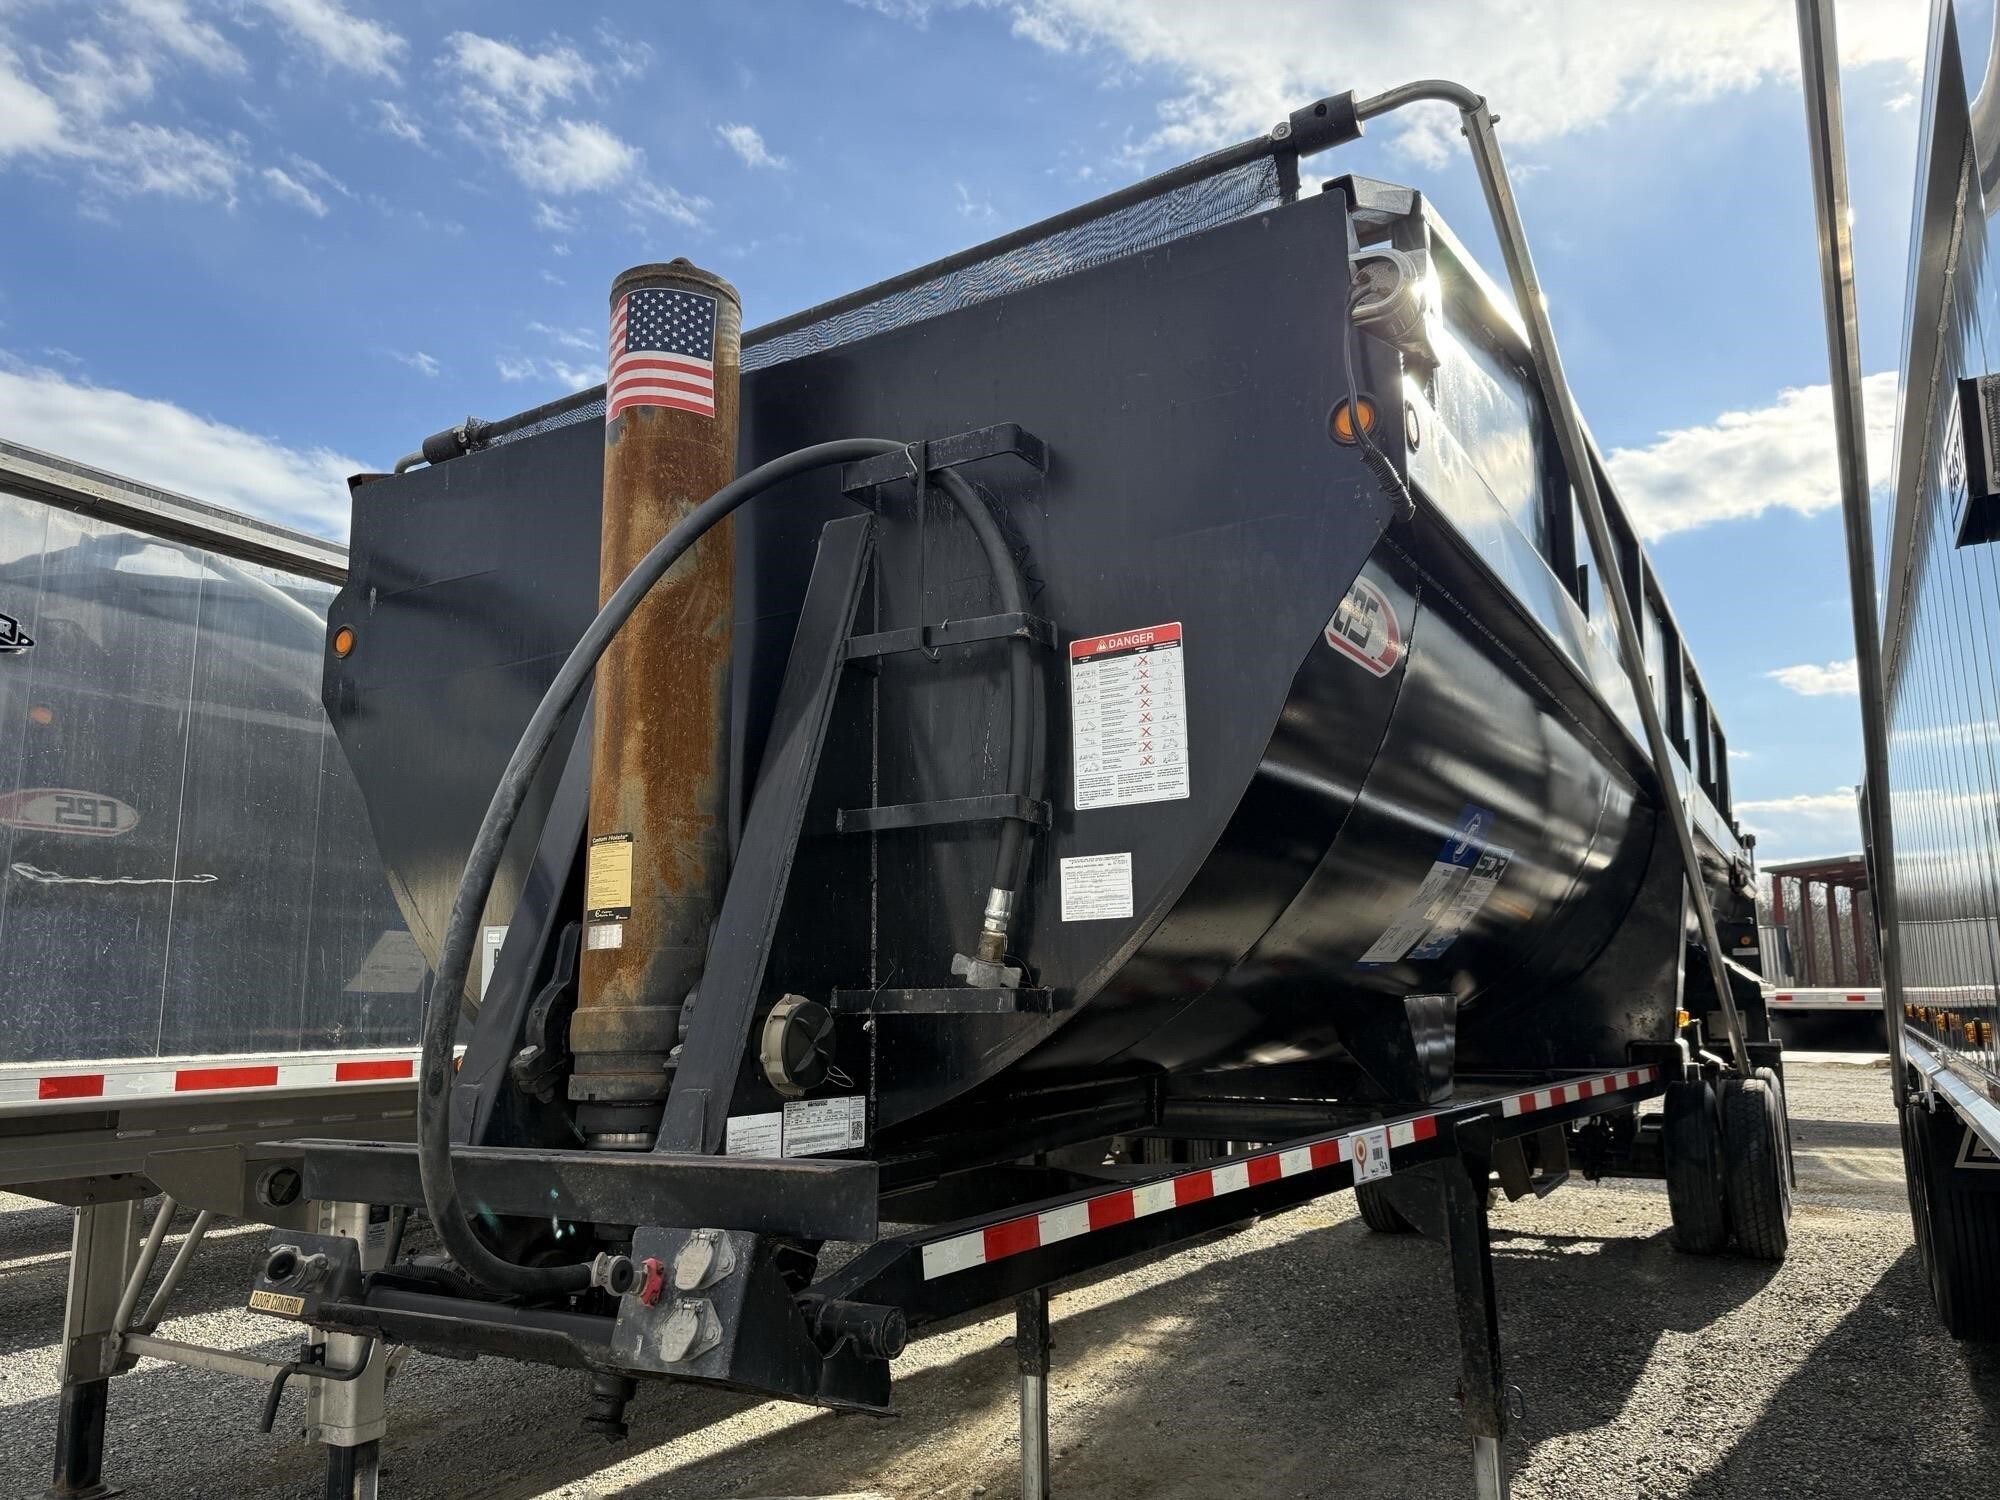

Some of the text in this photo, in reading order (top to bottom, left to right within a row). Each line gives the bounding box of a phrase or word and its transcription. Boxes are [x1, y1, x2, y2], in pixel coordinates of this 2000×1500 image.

[1108, 632, 1154, 648] DANGER
[252, 1292, 301, 1314] DOOR CONTROL
